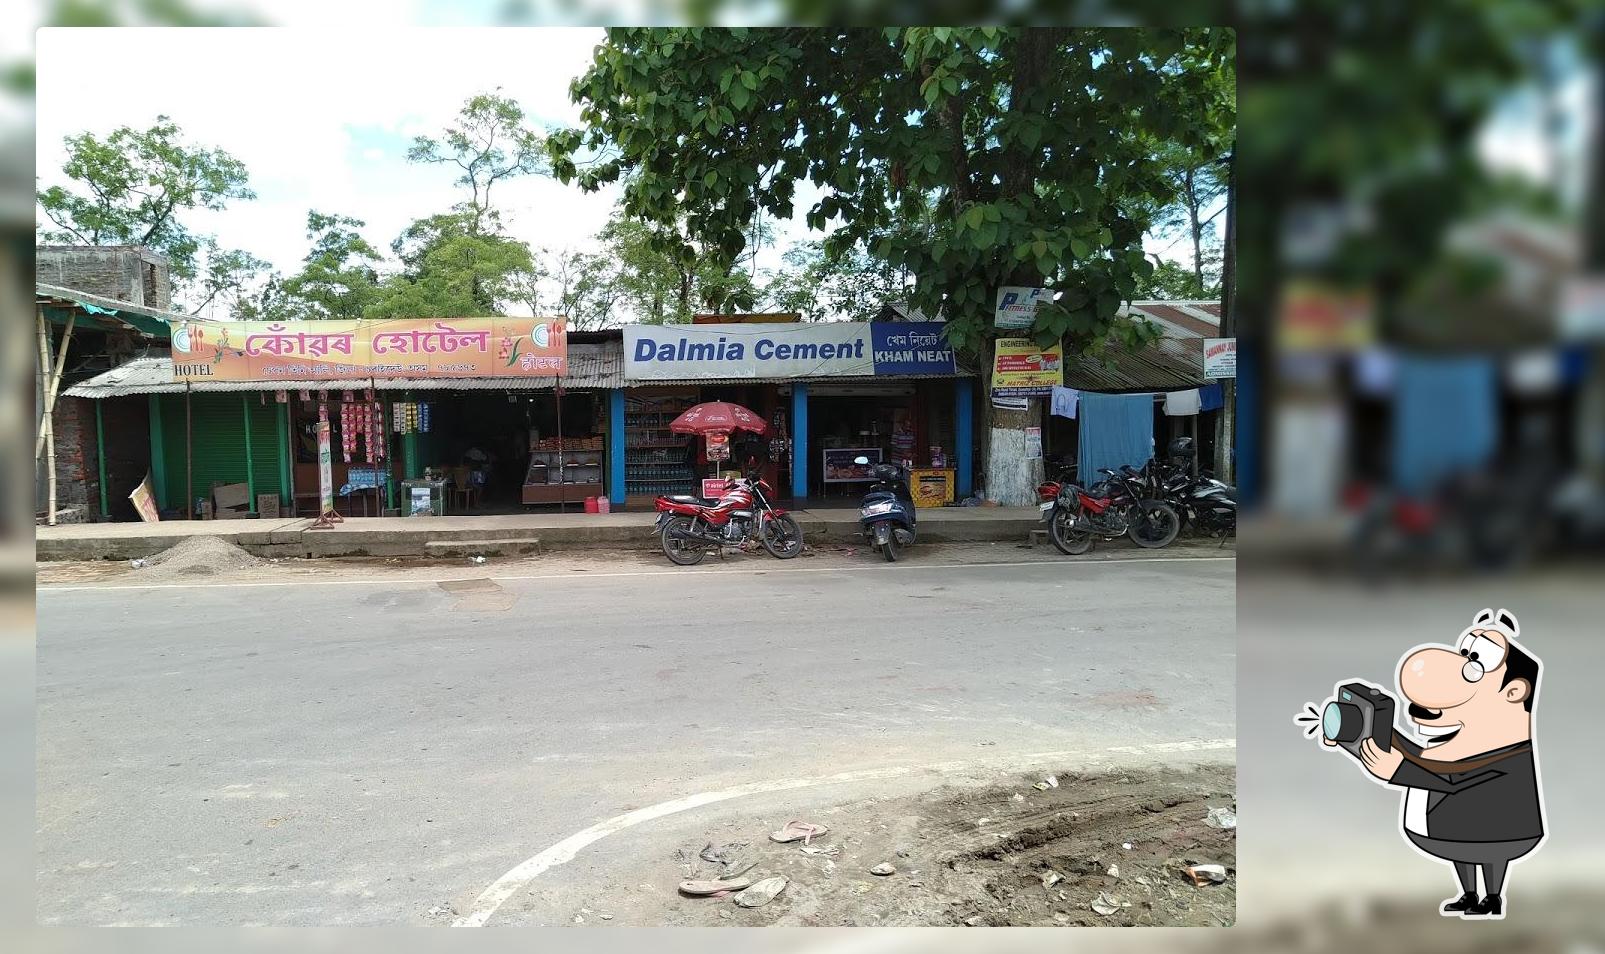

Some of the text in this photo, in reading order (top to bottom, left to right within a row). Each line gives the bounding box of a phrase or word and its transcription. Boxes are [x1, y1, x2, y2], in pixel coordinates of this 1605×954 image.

[244, 322, 491, 359] কোঁৱৰ হোটেল
[633, 337, 864, 362] Dalmia Cement
[874, 350, 952, 364] KHAM NEAT
[173, 364, 213, 376] HOTEL
[305, 424, 338, 434] HOL
